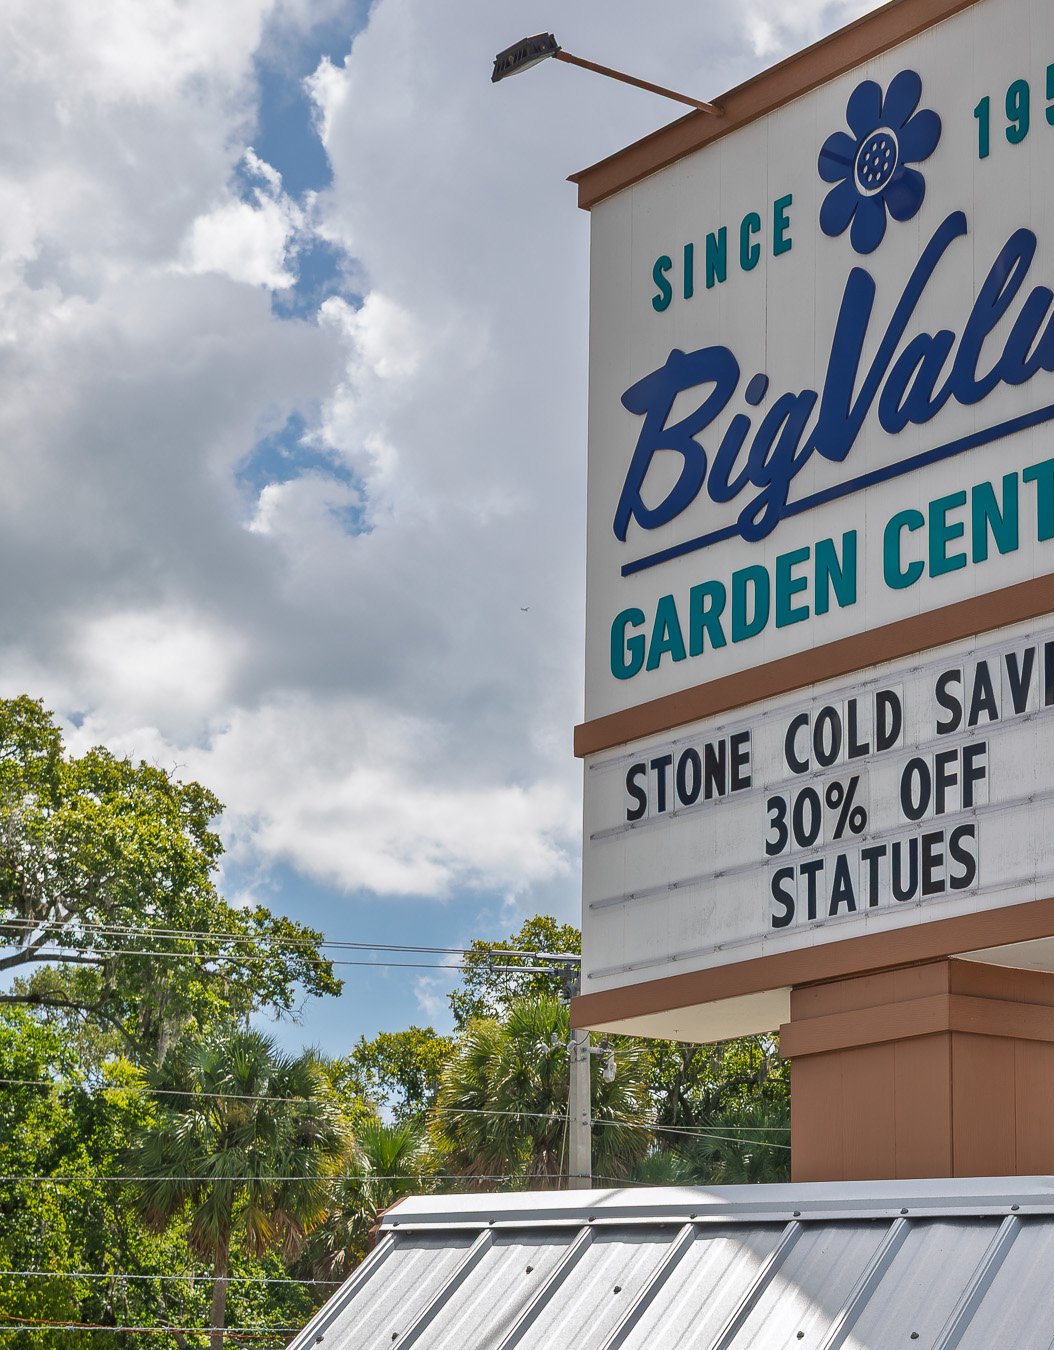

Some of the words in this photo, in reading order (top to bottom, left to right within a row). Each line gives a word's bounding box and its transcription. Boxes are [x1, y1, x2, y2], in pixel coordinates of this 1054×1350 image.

[651, 193, 794, 313] SINCE
[609, 529, 858, 681] GARDEN
[624, 730, 752, 821] STONE
[784, 689, 902, 774] COLD
[765, 775, 868, 856] 30%
[900, 741, 987, 821] OFF
[770, 823, 977, 929] STATUES
